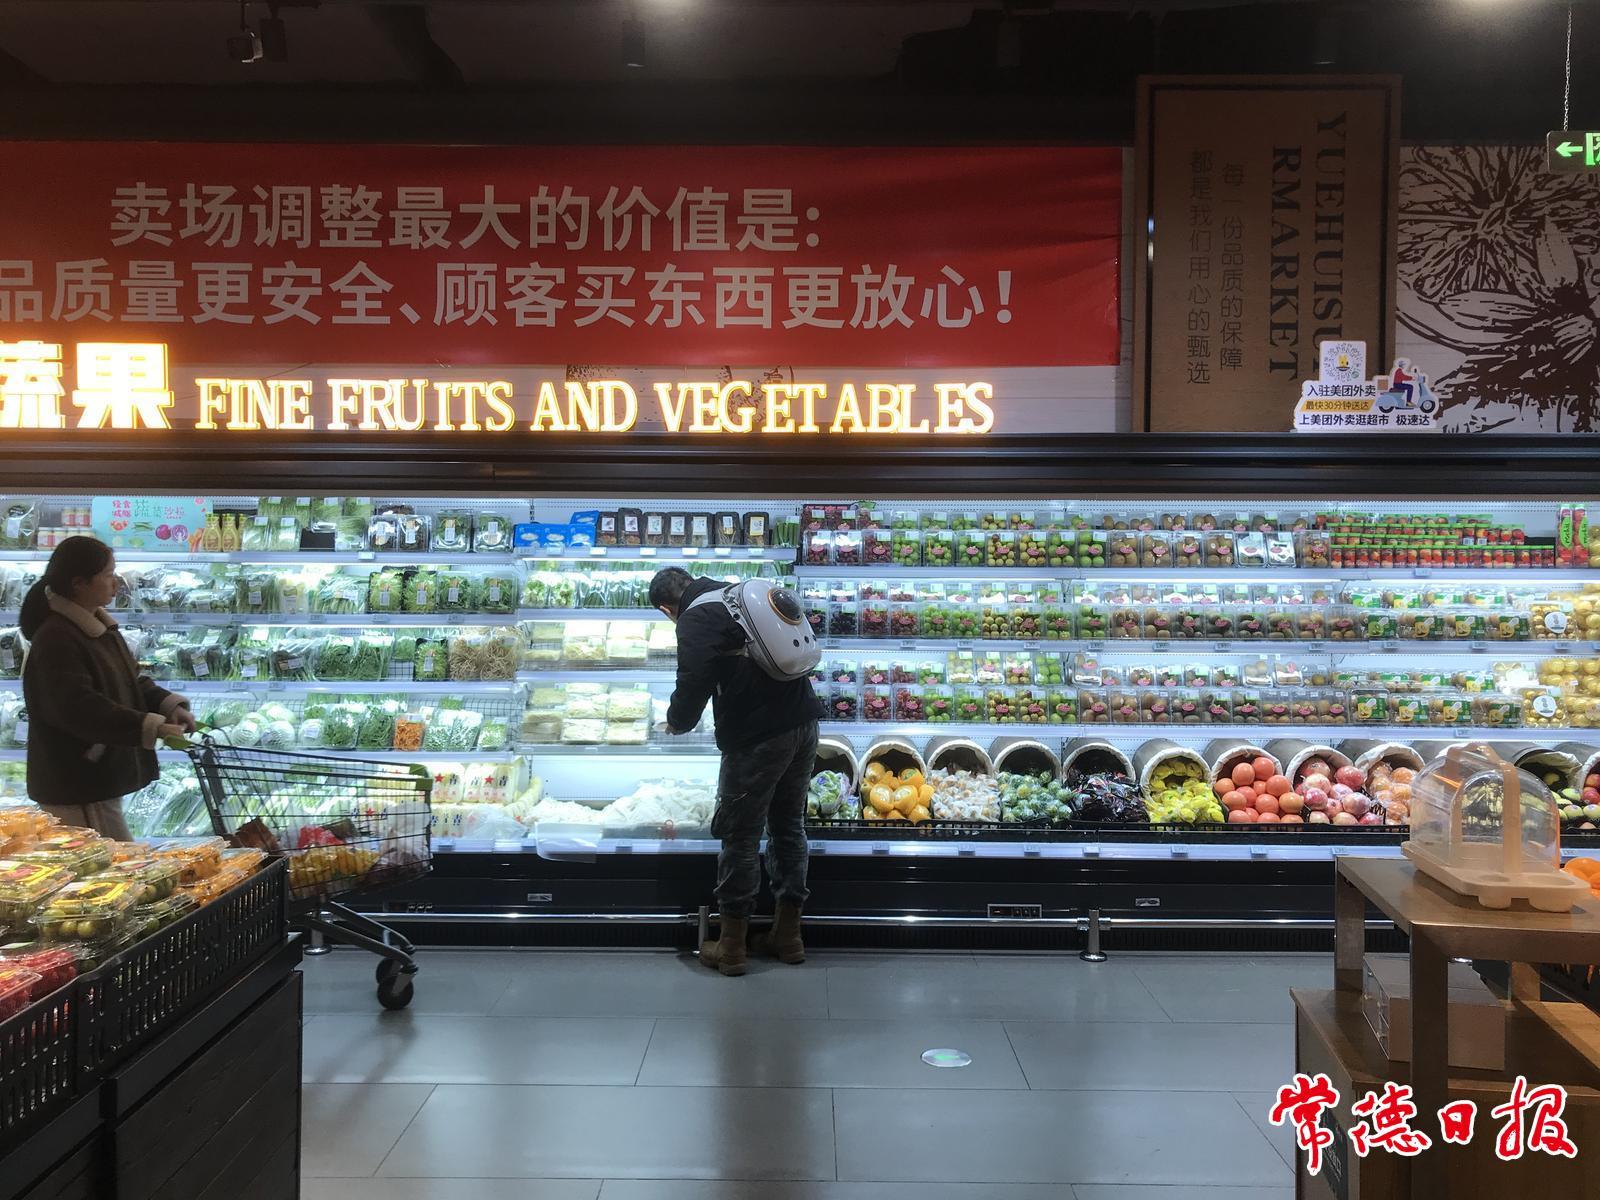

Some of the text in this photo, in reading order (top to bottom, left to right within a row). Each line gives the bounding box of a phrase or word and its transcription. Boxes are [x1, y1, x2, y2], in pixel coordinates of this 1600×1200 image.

[110, 181, 820, 252] 卖场调整最大的价值是：
[1313, 112, 1346, 372] YUEHUISU
[0, 258, 1012, 330] 品质量更安全、顾客买东西更放心！
[1186, 149, 1214, 386] 都是我们用心的甄选
[1219, 162, 1246, 372] 每一份品质的保障
[1269, 145, 1303, 381] RMARKET
[194, 378, 995, 434] FINE FRUITS AND VEGETABLES
[1299, 414, 1430, 426] 上美团外卖逛超市 极速达
[1305, 400, 1370, 411] 最快30分钟送达
[1307, 385, 1376, 397] 入驻美团外卖
